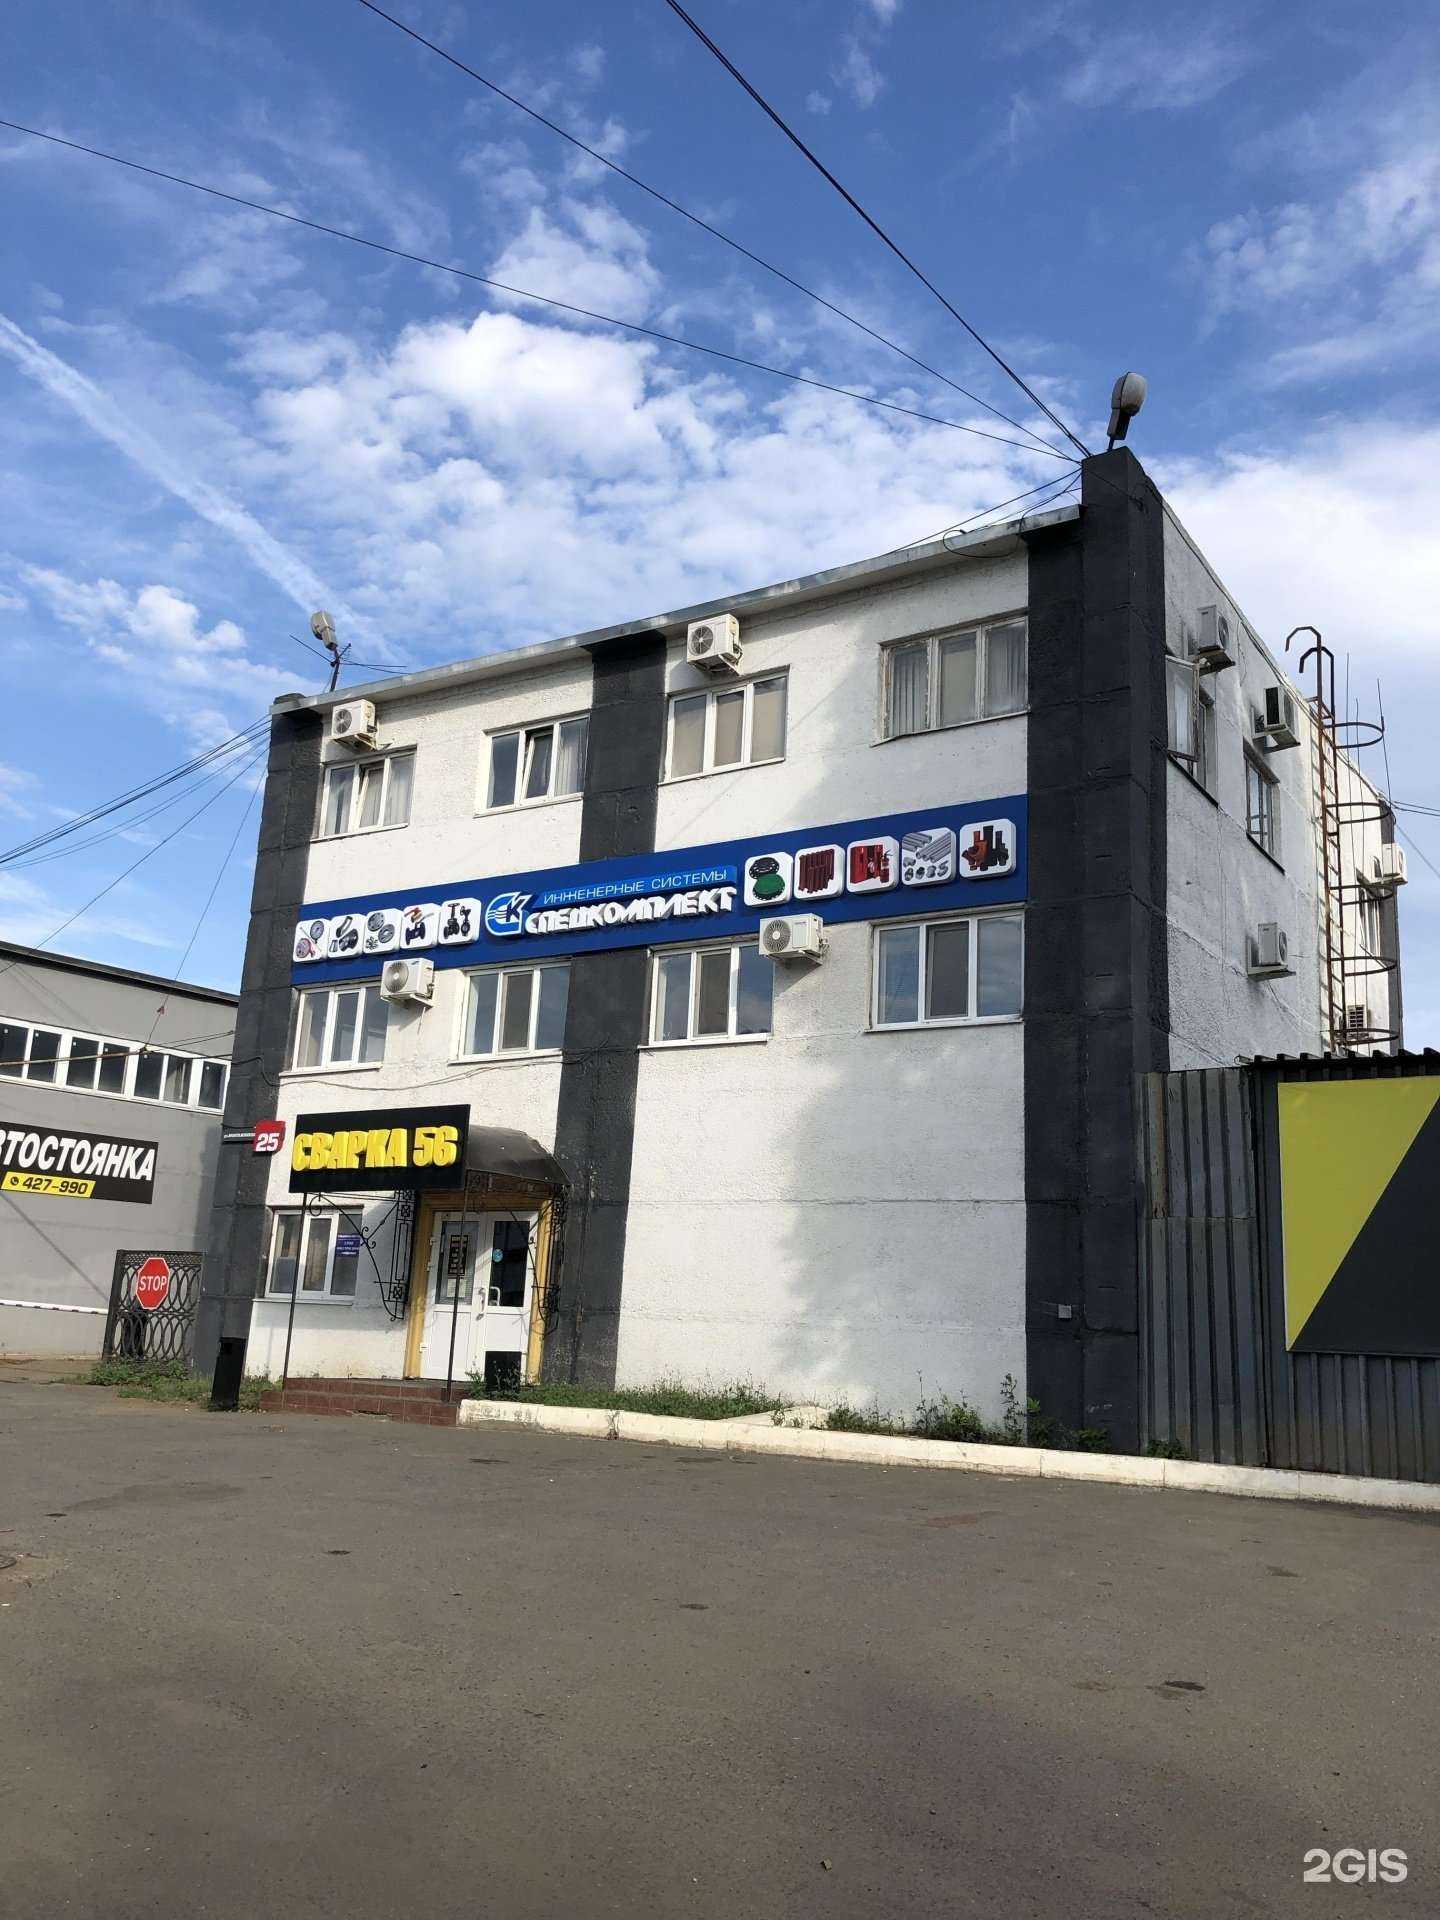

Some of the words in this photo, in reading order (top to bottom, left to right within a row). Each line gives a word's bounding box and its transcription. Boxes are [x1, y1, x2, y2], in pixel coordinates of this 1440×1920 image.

[544, 881, 645, 905] ИНЖЕНЕРНЫЕ
[651, 870, 727, 889] СИСТЕМЫ
[525, 886, 738, 934] СПЕЦКОМПЛЕКТ
[255, 1132, 280, 1152] 25
[292, 1128, 408, 1172] СВАРКА
[412, 1125, 459, 1167] 56
[22, 1176, 89, 1195] 427-990
[139, 1275, 167, 1291] STOP
